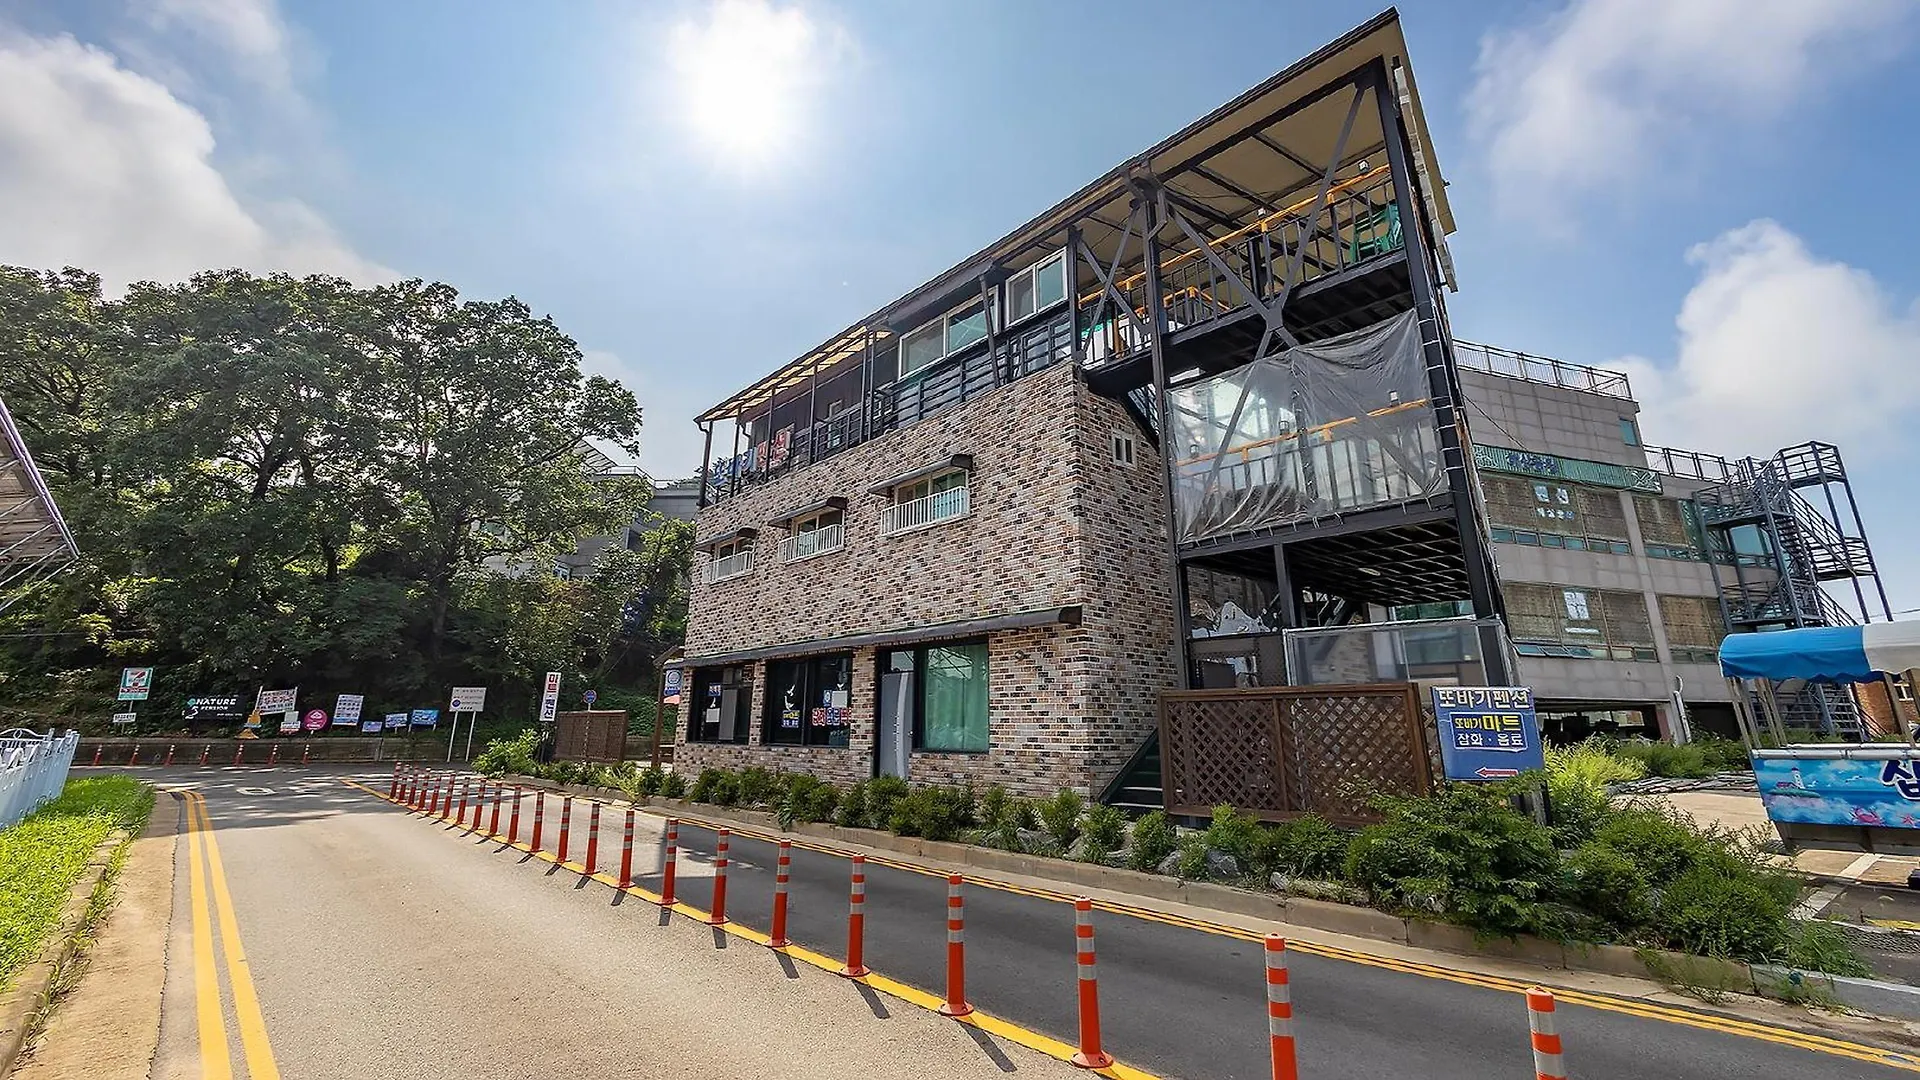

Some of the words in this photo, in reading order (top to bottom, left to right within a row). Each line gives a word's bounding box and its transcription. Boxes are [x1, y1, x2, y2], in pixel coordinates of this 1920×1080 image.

[195, 698, 237, 706] NATURE
[1439, 690, 1530, 708] 또바기펜션
[1497, 733, 1523, 746] 음료
